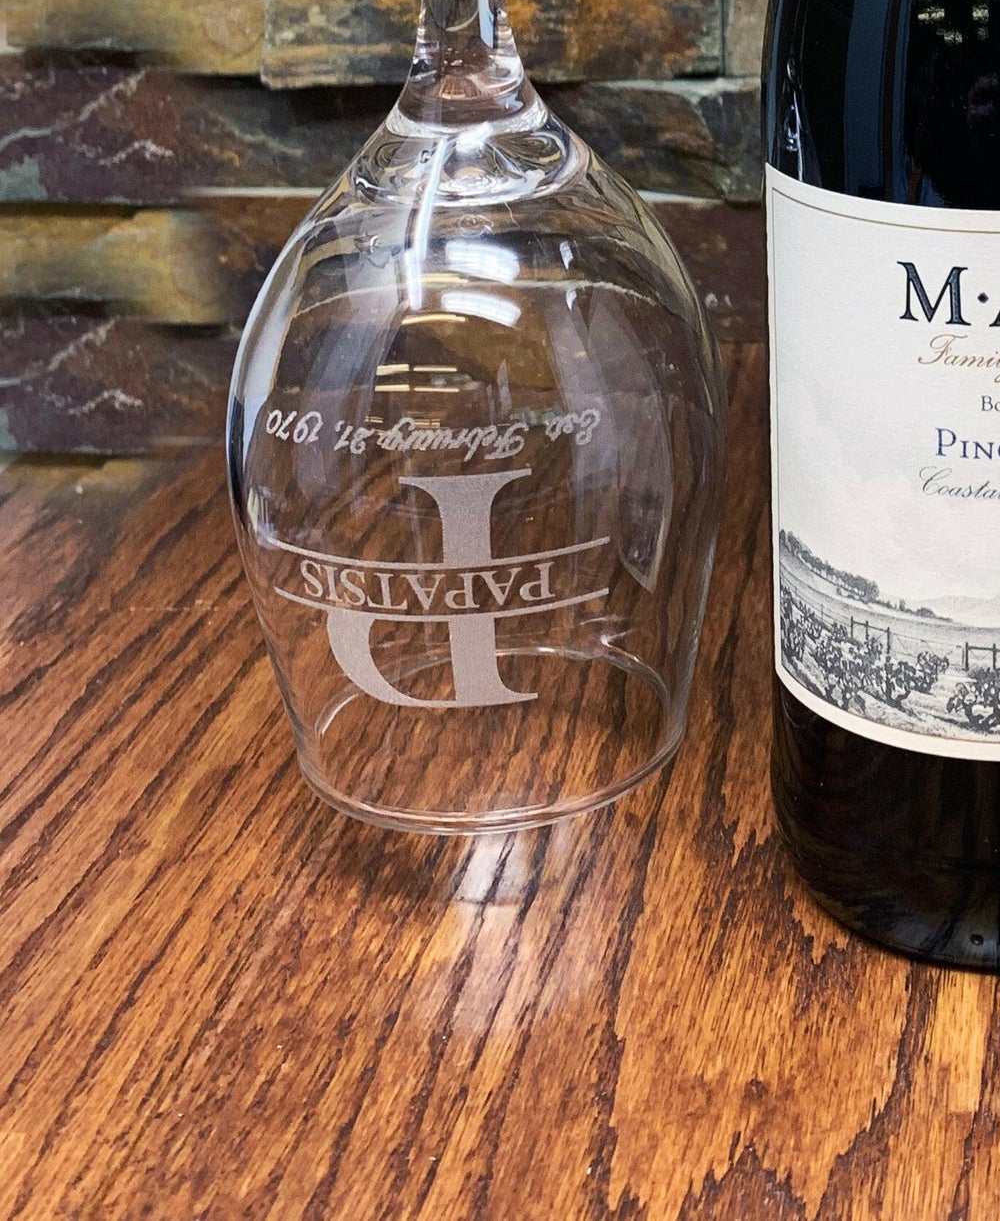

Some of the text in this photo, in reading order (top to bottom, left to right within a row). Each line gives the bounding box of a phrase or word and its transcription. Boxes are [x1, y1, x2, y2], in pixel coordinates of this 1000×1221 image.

[265, 408, 324, 444] 1970
[378, 417, 530, 462] February
[300, 559, 557, 611] PAPATSIS
